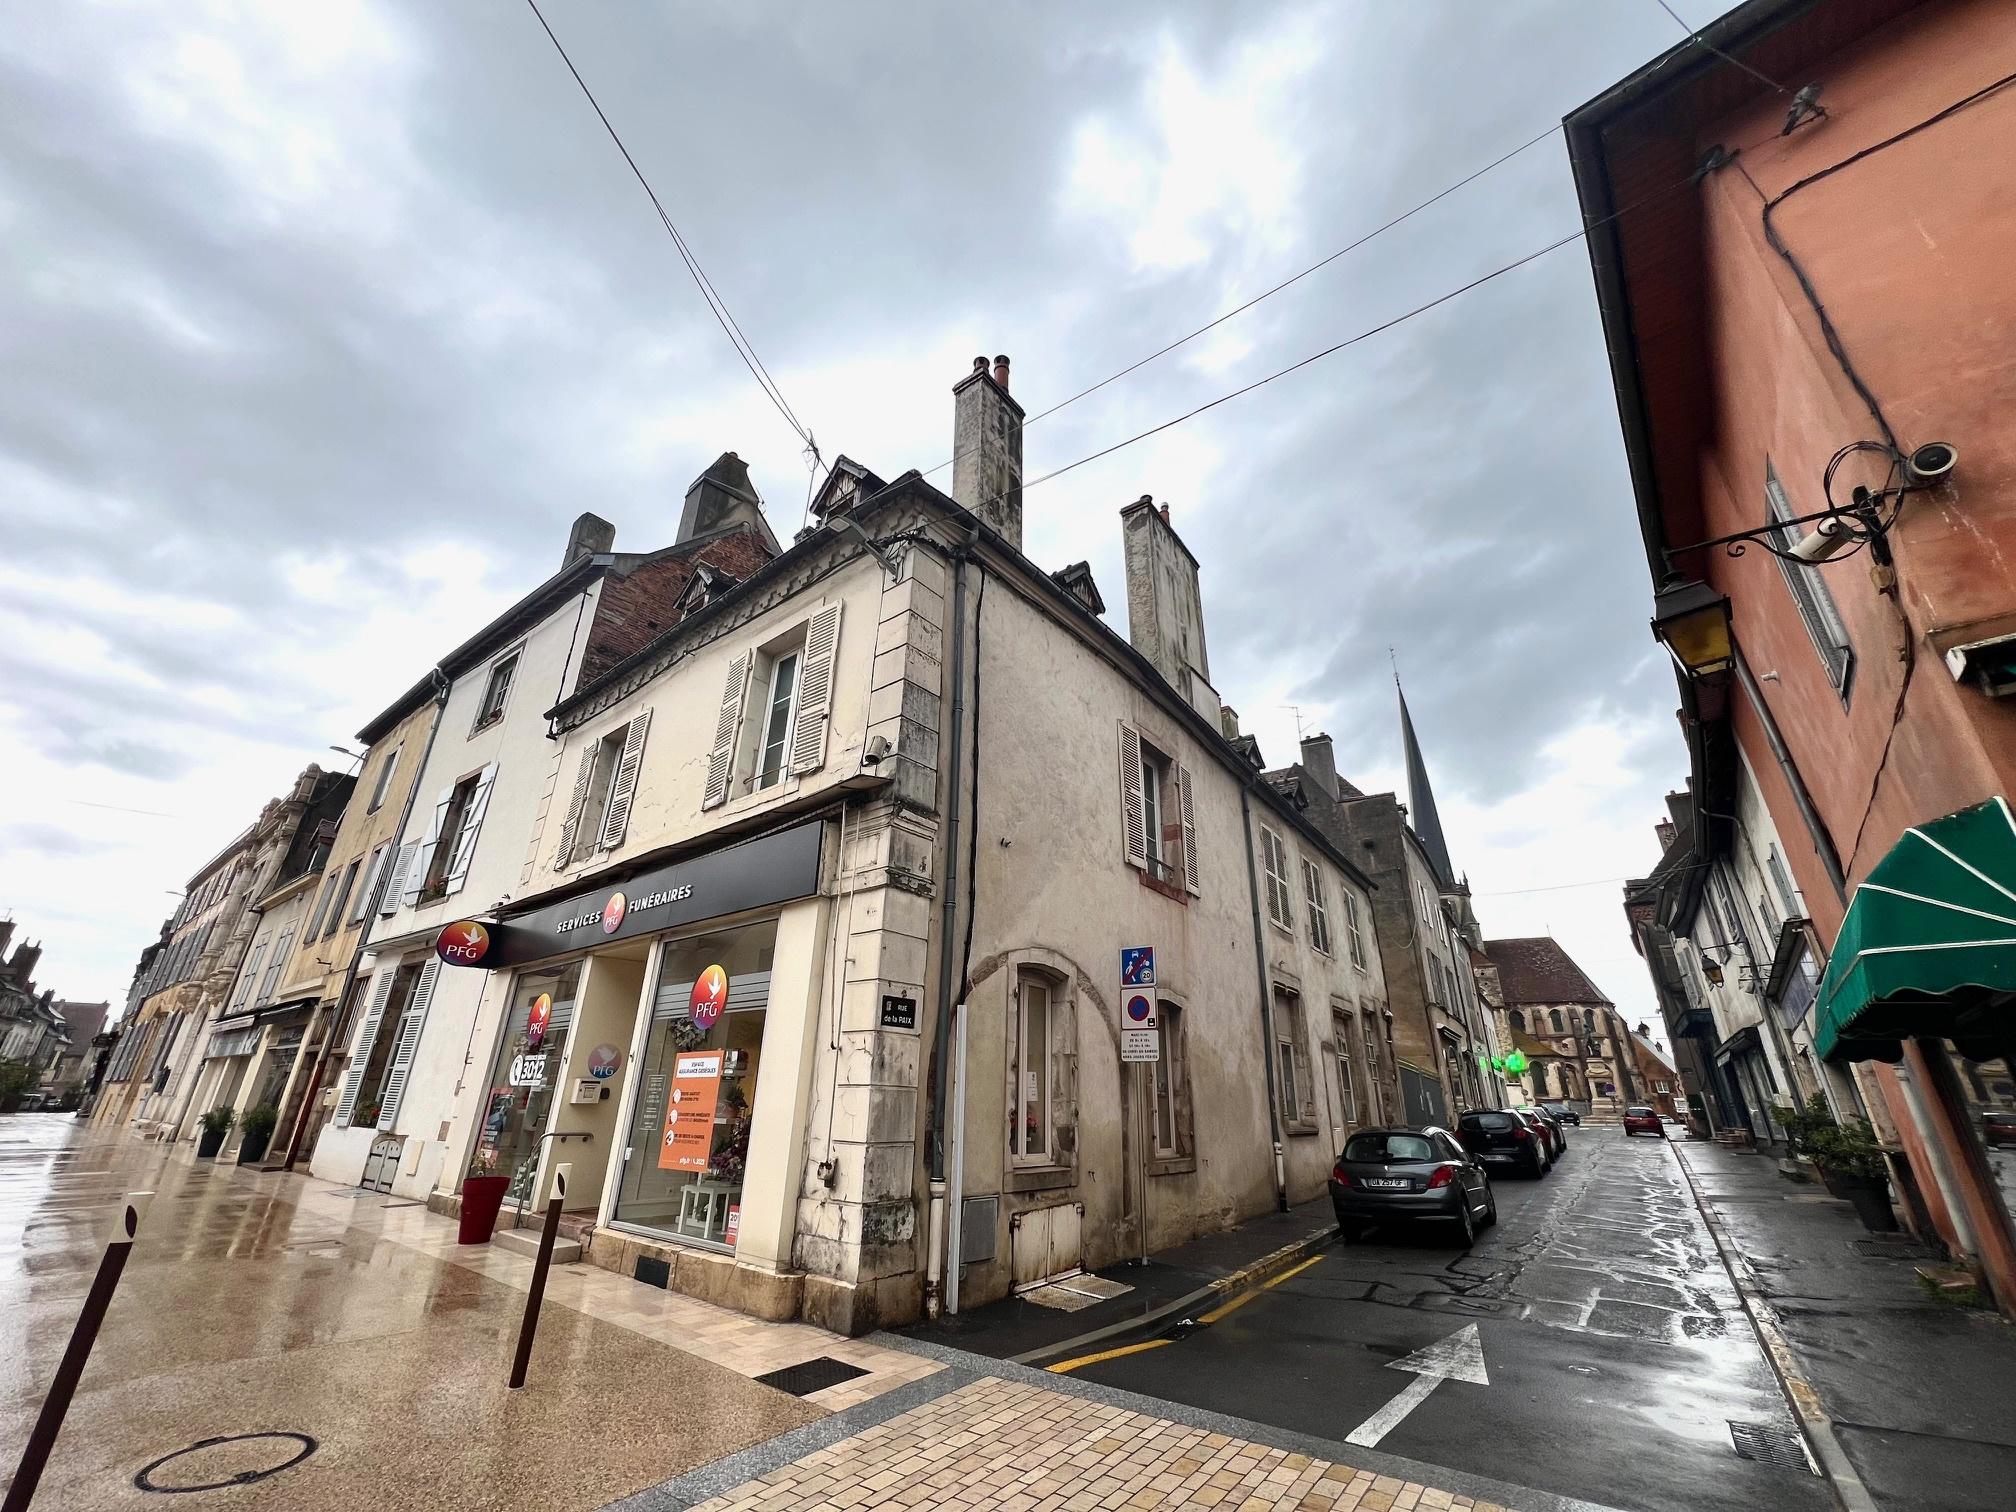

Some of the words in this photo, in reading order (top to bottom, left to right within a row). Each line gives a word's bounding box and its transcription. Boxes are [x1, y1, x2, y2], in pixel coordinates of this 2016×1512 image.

[628, 885, 692, 914] FUNÉRAIRES
[556, 910, 601, 934] SERVICES
[605, 915, 618, 927] PFG
[446, 944, 477, 958] PFG
[695, 1001, 718, 1018] PFG
[892, 1015, 897, 1023] la
[898, 1016, 912, 1024] PAIX
[529, 1022, 543, 1035] PFG
[521, 1060, 545, 1080] 3012
[593, 1065, 615, 1076] PFG
